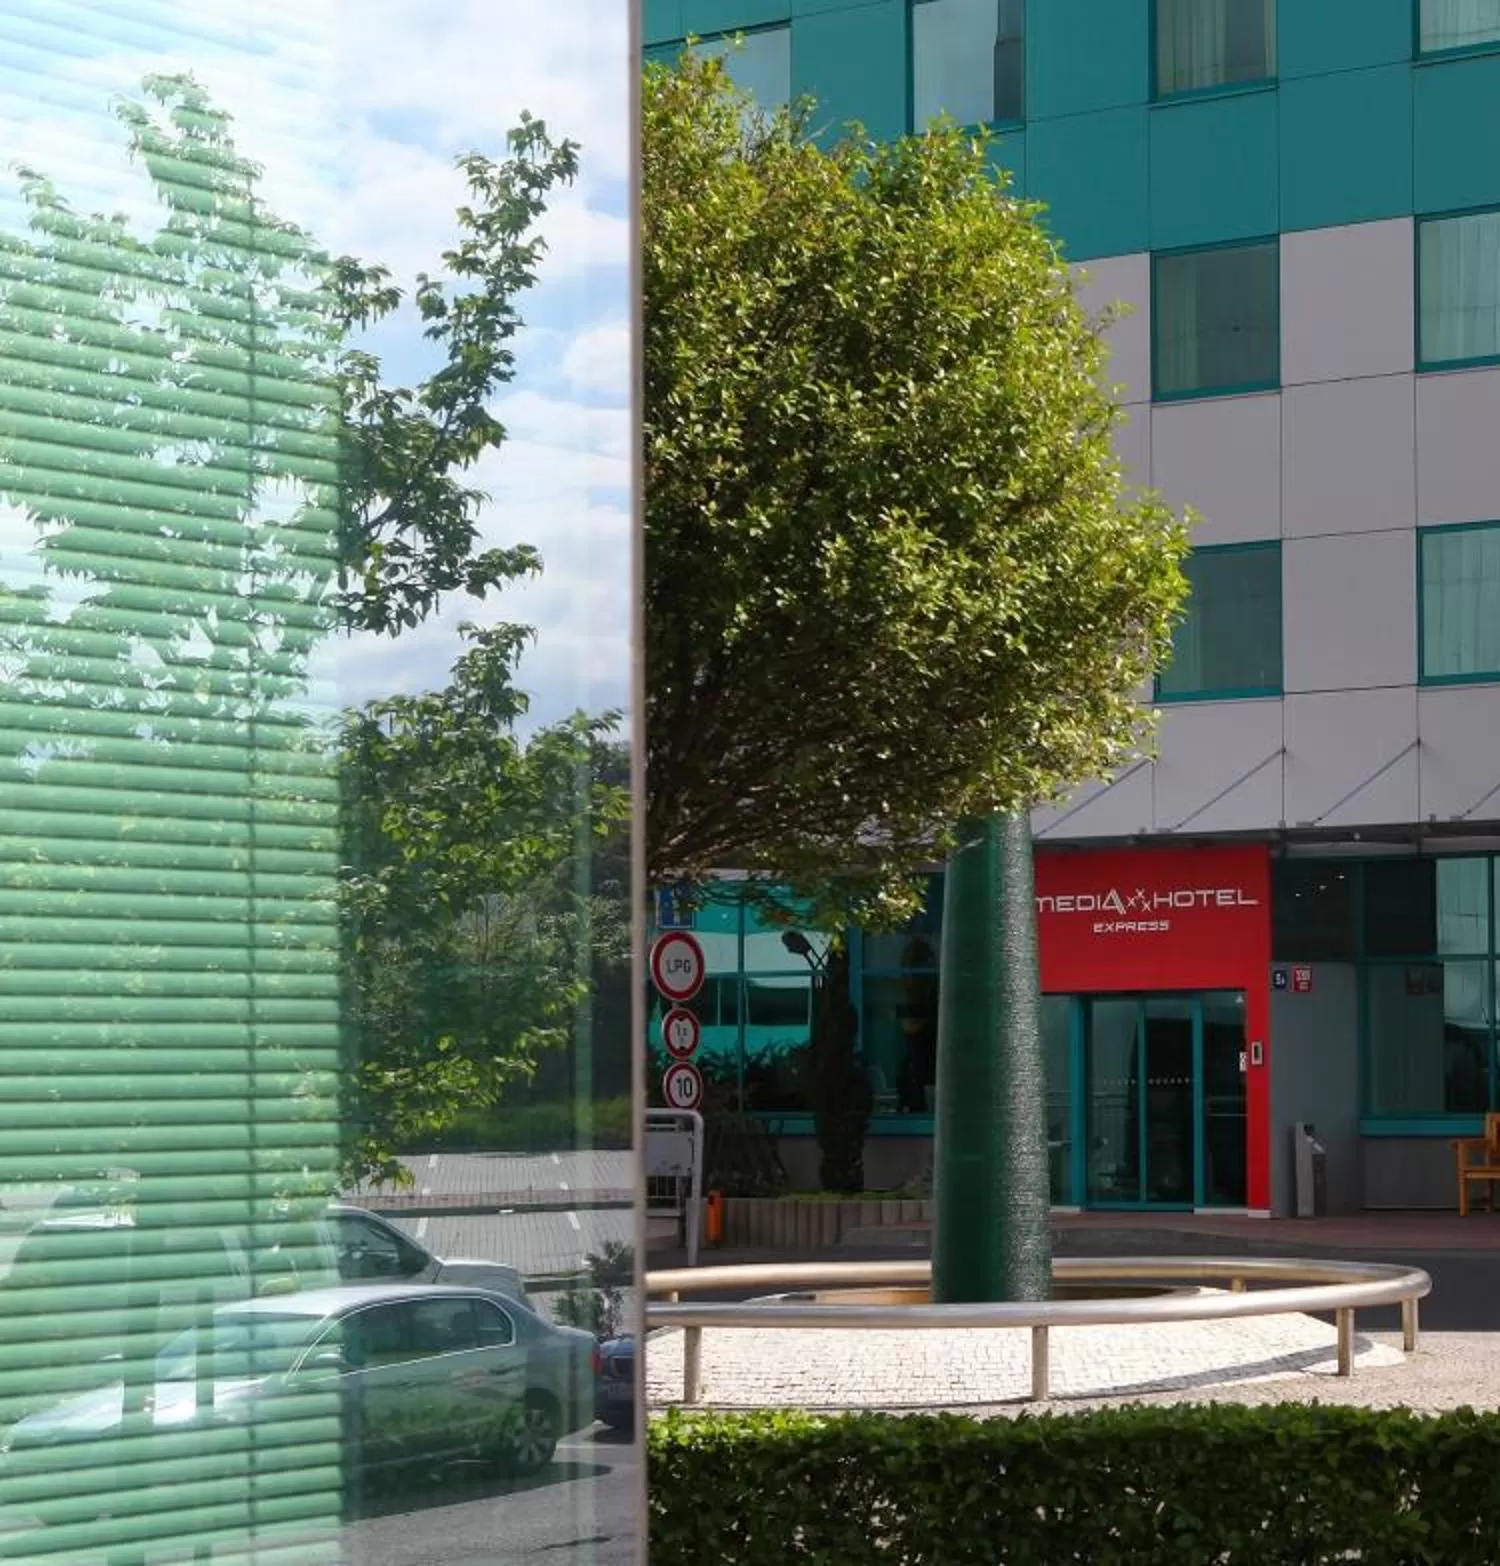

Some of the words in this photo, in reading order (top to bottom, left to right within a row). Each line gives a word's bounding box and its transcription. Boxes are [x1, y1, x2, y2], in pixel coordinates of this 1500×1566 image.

[1153, 889, 1259, 908] HOTEL
[1093, 919, 1170, 933] EXPRESS
[666, 959, 692, 974] LPG
[676, 1077, 693, 1098] 10
